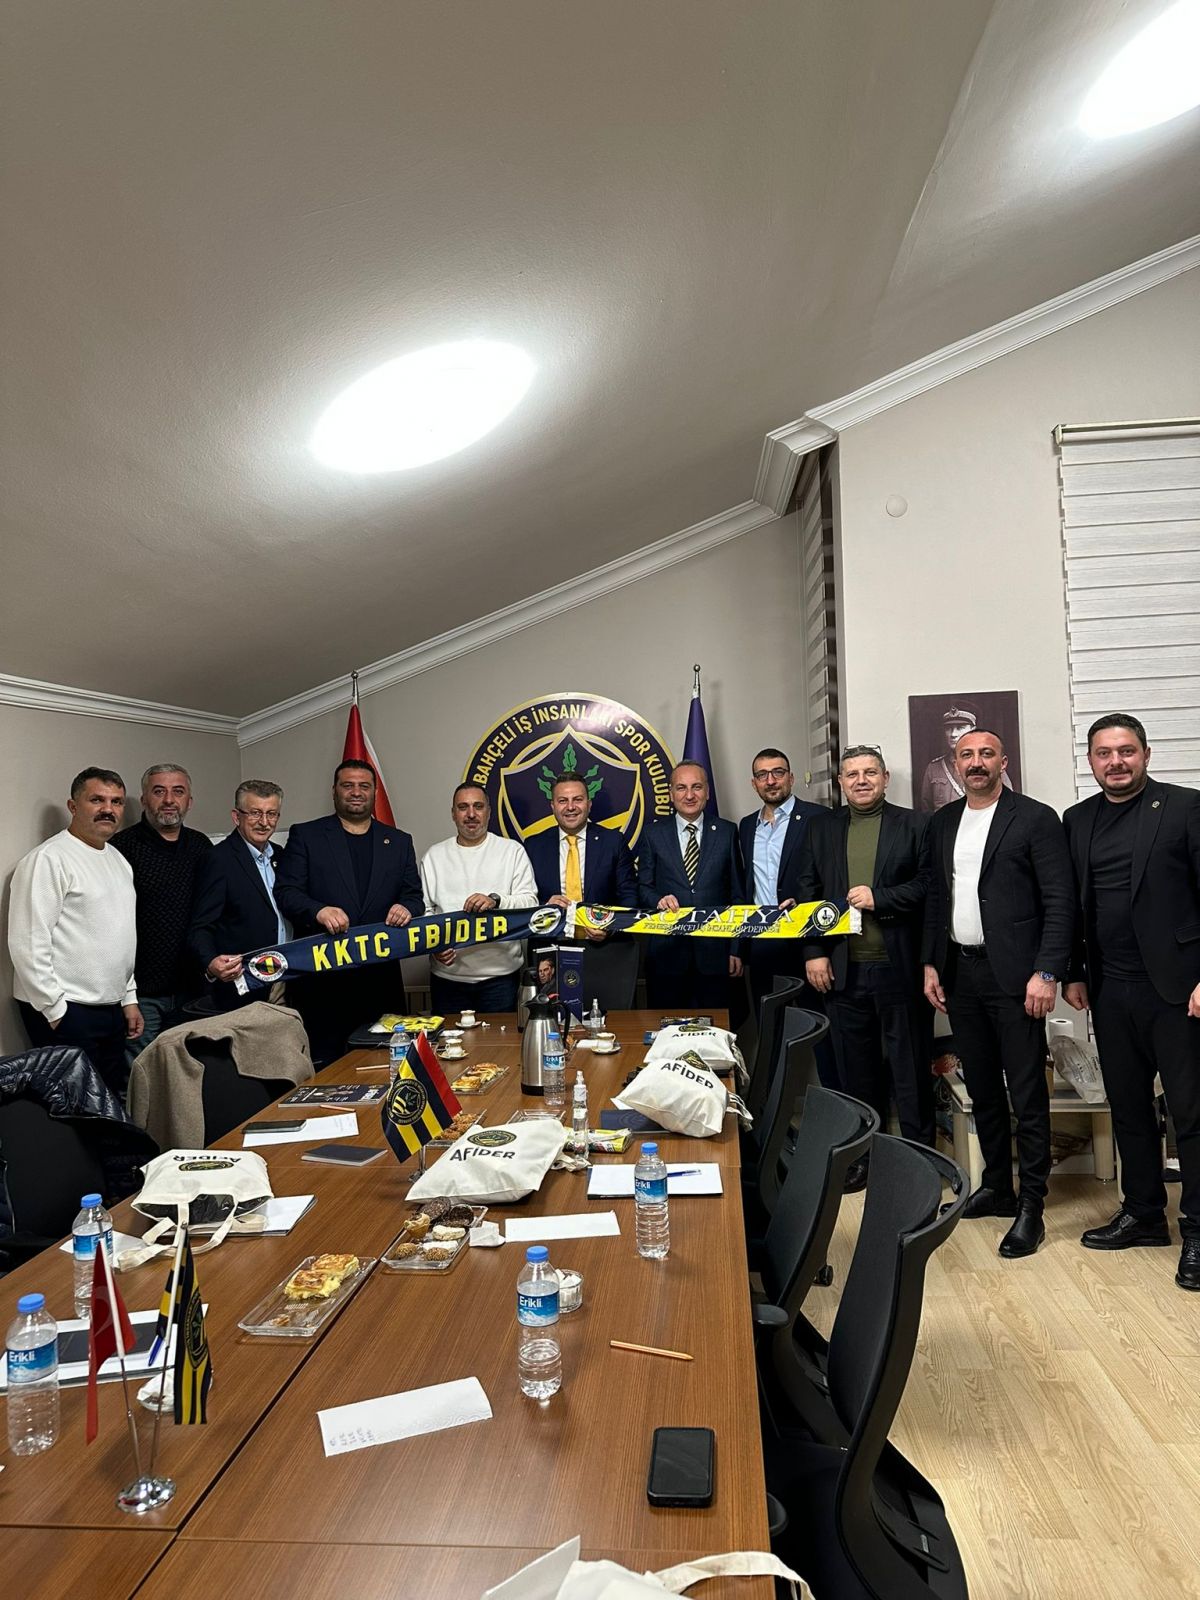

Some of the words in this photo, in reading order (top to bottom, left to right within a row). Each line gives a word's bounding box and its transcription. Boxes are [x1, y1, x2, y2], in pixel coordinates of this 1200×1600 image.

[472, 723, 517, 787] BAHÇELİ
[614, 719, 651, 756] SPOR
[643, 753, 674, 816] KULÜBÜ
[312, 932, 390, 972] KKTC
[519, 1296, 543, 1308] Erikli
[9, 1351, 36, 1362] Erikli
